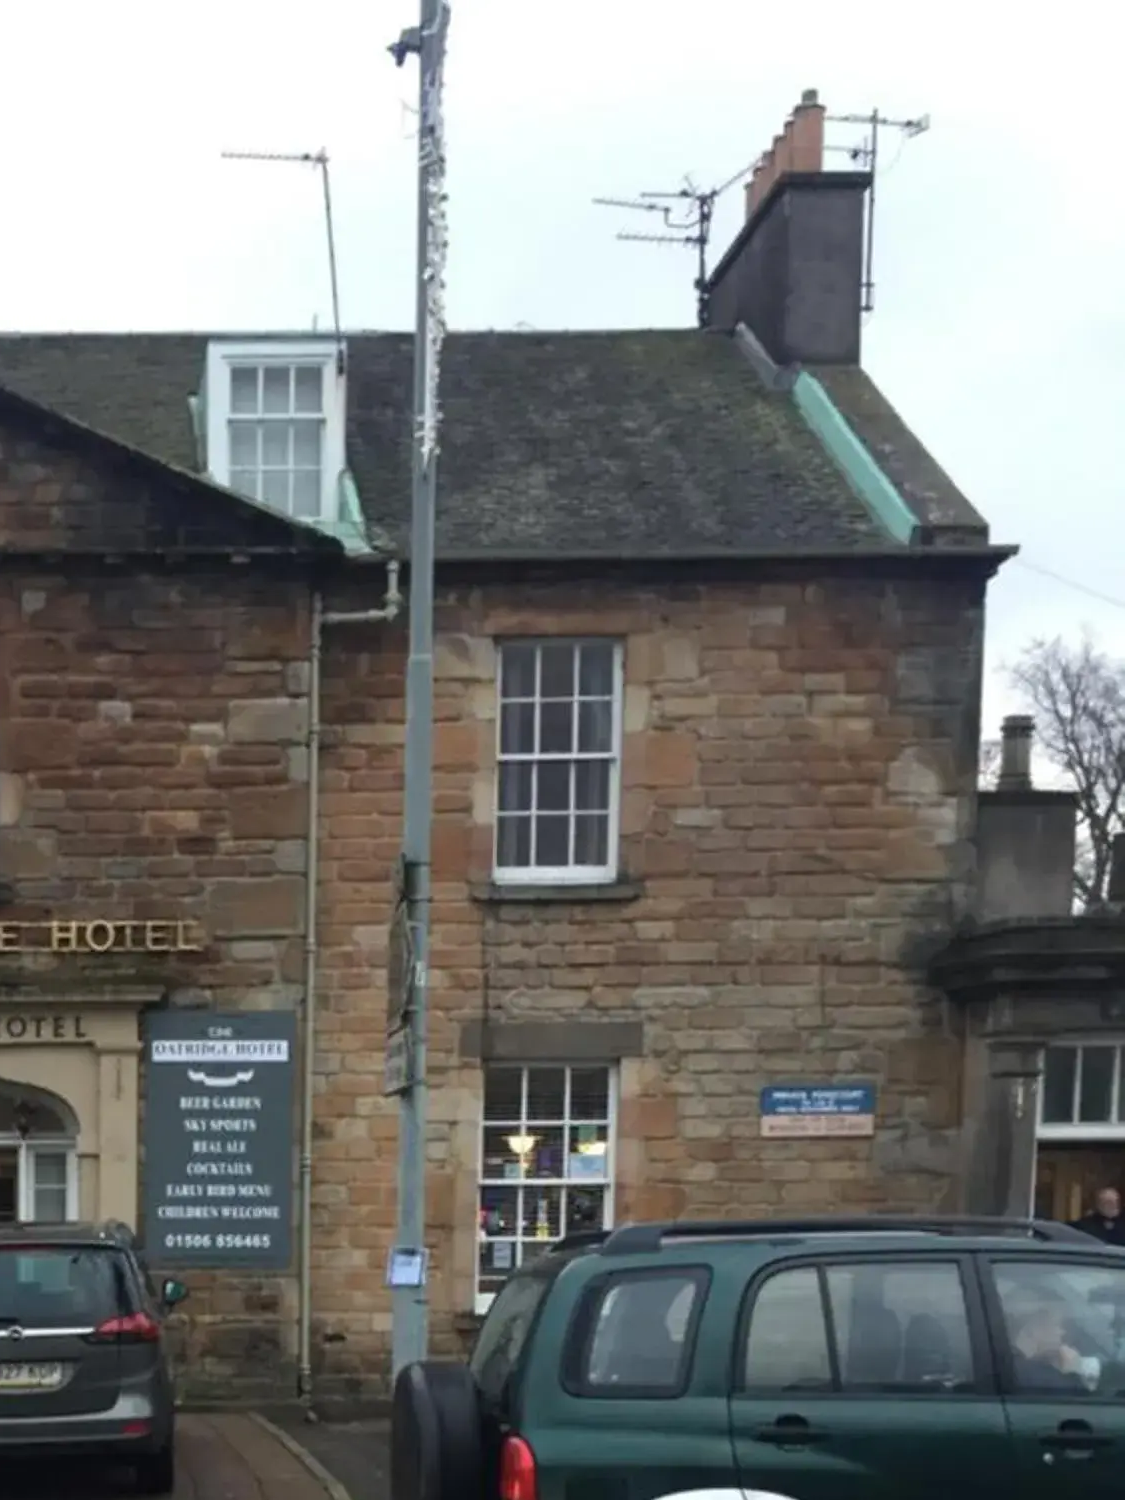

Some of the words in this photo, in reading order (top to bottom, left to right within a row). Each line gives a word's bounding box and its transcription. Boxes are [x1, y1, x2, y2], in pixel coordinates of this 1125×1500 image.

[50, 918, 203, 952] HOTEL
[154, 1043, 230, 1056] OATRIDGE
[235, 1043, 283, 1056] HOTEL
[179, 1096, 210, 1110] BEER
[212, 1096, 262, 1110] GARDEN
[183, 1119, 207, 1132] SKY
[209, 1119, 257, 1132] SPORTS
[192, 1140, 222, 1153] REAL
[226, 1140, 247, 1153] ALE
[186, 1162, 254, 1176] COCKTAILS
[165, 1184, 204, 1197] EARLY
[206, 1184, 236, 1197] BIRD
[237, 1184, 273, 1197] MENU
[157, 1205, 219, 1219] CHILDREN
[220, 1205, 280, 1219] WELCOME
[165, 1234, 211, 1248] 01506
